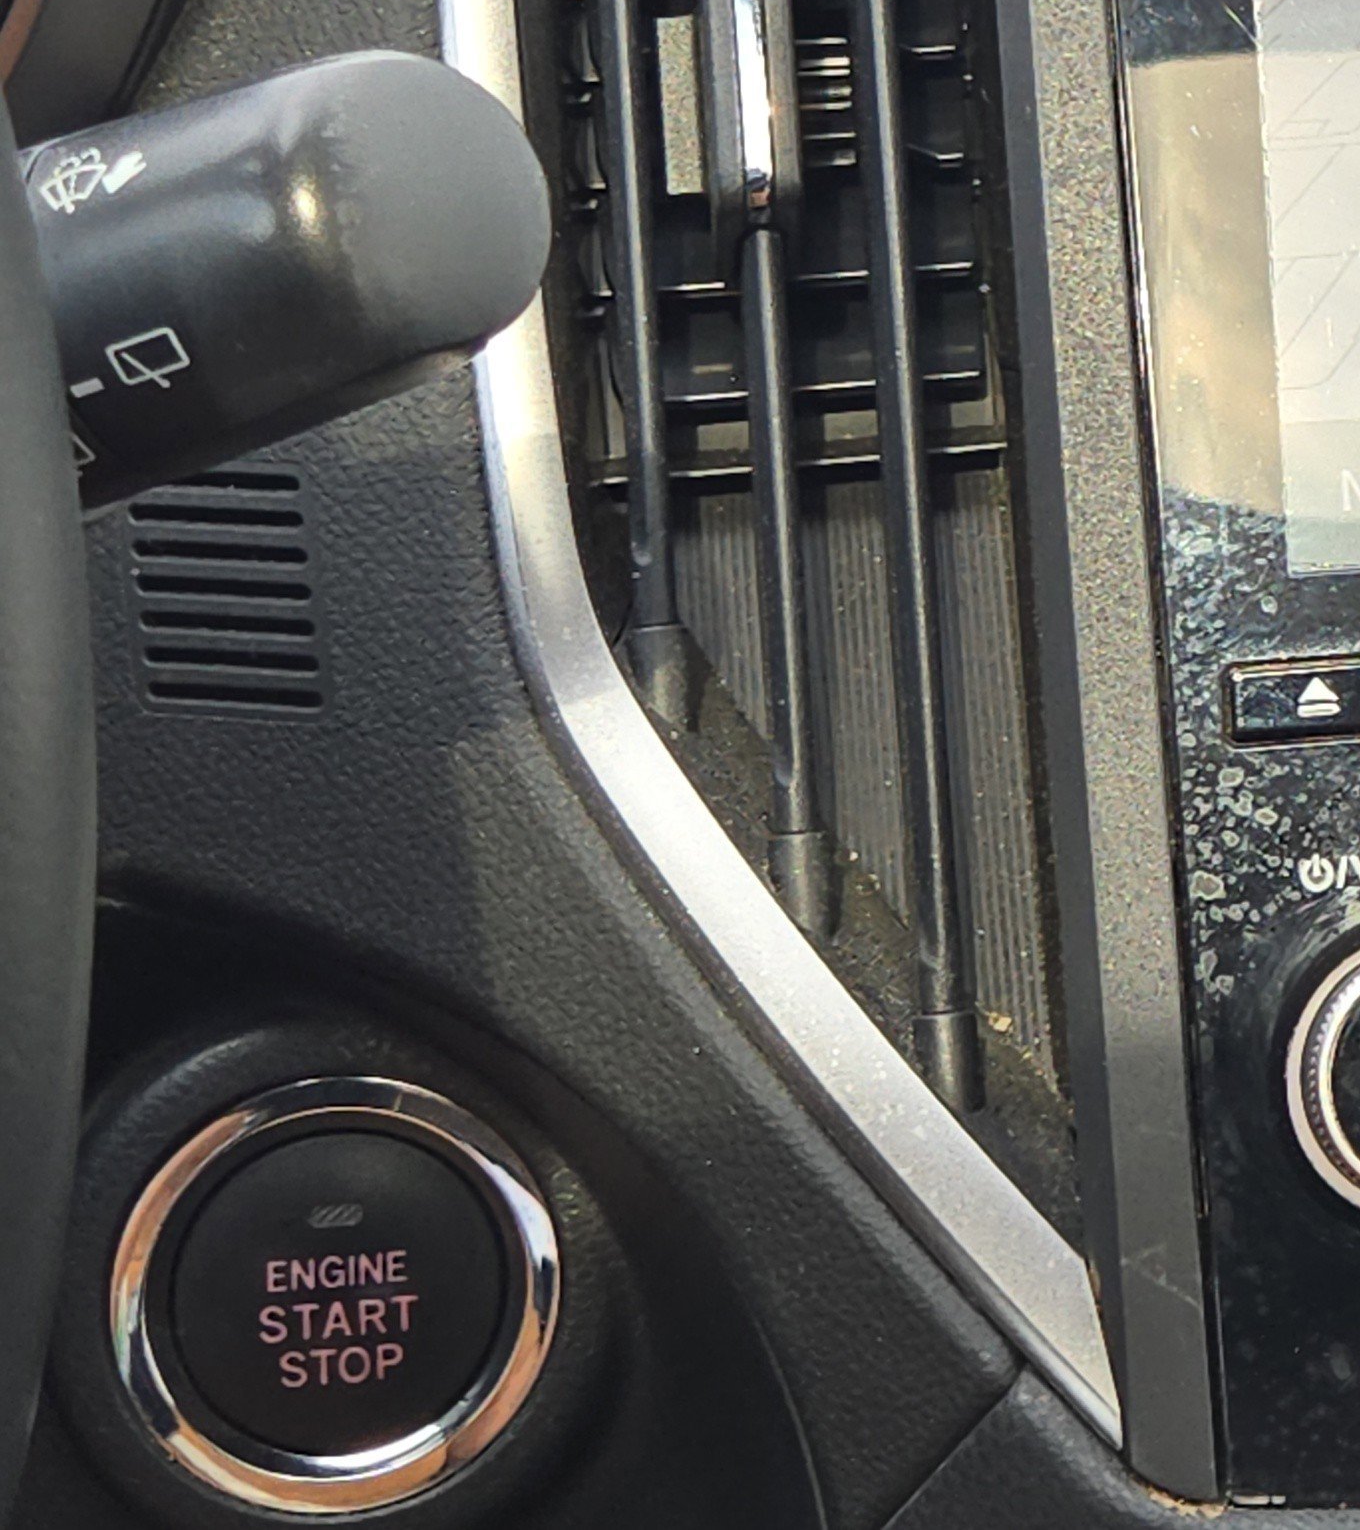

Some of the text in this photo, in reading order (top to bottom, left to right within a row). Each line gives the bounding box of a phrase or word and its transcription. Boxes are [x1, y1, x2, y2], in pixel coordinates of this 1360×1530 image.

[265, 1250, 408, 1294] ENGINE
[257, 1293, 419, 1345] START
[278, 1343, 405, 1389] STOP
